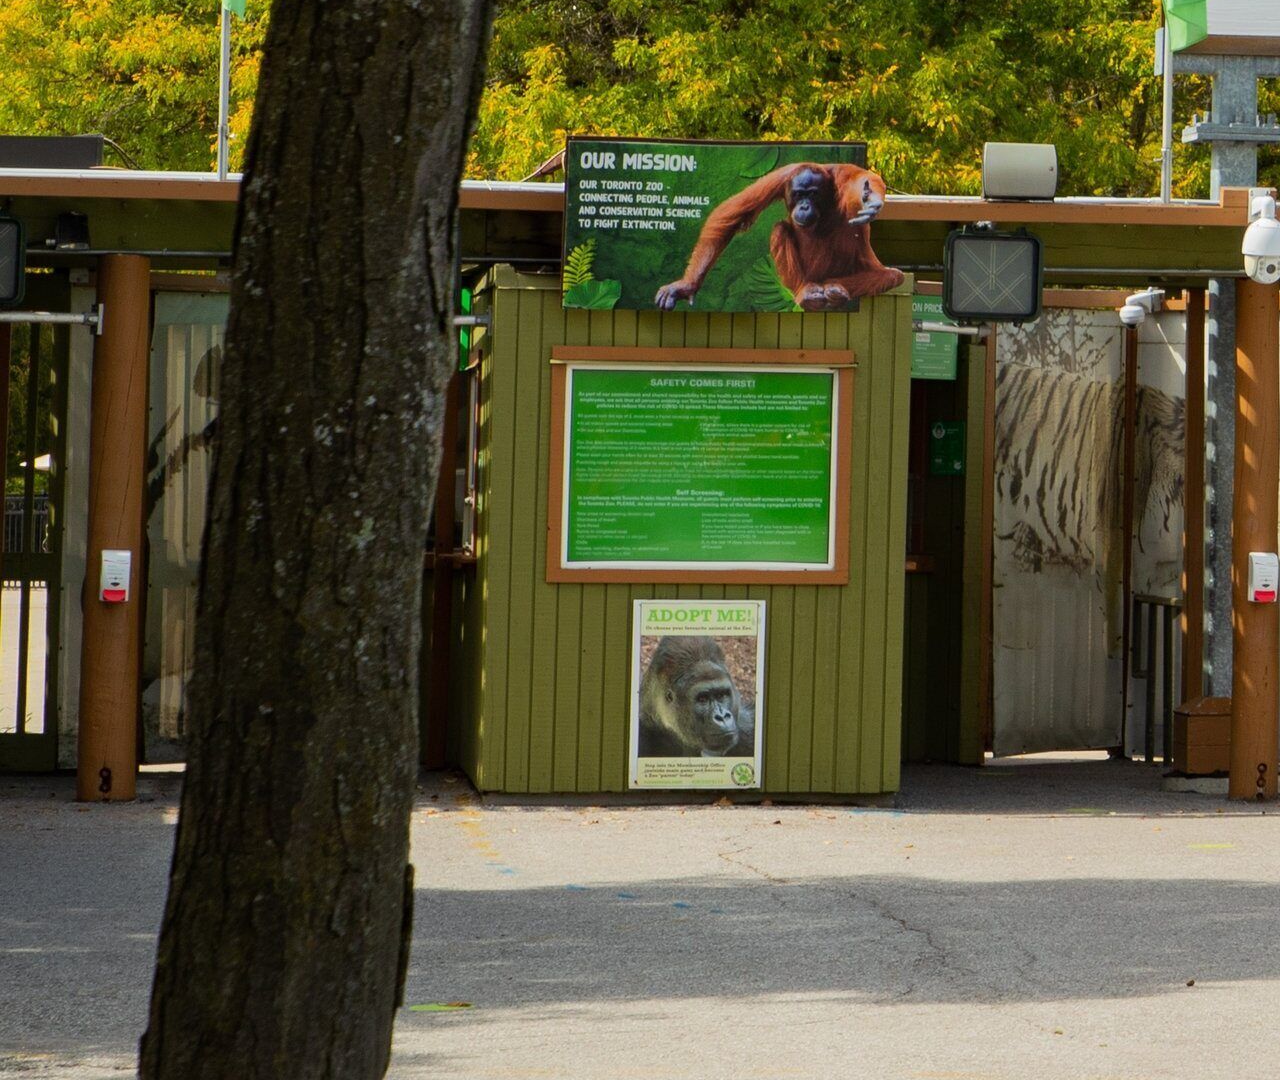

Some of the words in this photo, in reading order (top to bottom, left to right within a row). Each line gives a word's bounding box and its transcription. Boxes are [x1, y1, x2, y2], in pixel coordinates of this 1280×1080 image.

[580, 151, 616, 169] OUR
[622, 153, 697, 172] MISSION:
[579, 180, 598, 190] OUR
[601, 180, 643, 190] TORONTO
[645, 181, 663, 191] ZOO
[579, 193, 633, 203] CONNECTING
[636, 194, 670, 205] PEOPLE,
[673, 196, 710, 206] ANIMALS
[578, 206, 596, 215] AND
[599, 206, 663, 217] CONSERVATION
[666, 208, 702, 218] SCIENCE
[578, 218, 591, 228] TO
[593, 219, 620, 229] FIGHT
[622, 220, 676, 231] EXTINCTION.
[923, 303, 944, 313] PRICE
[650, 378, 687, 387] SAFETY
[689, 379, 724, 388] COMES
[726, 379, 756, 388] FIRST!
[647, 609, 712, 622] ADOPT
[716, 609, 752, 623] ME!
